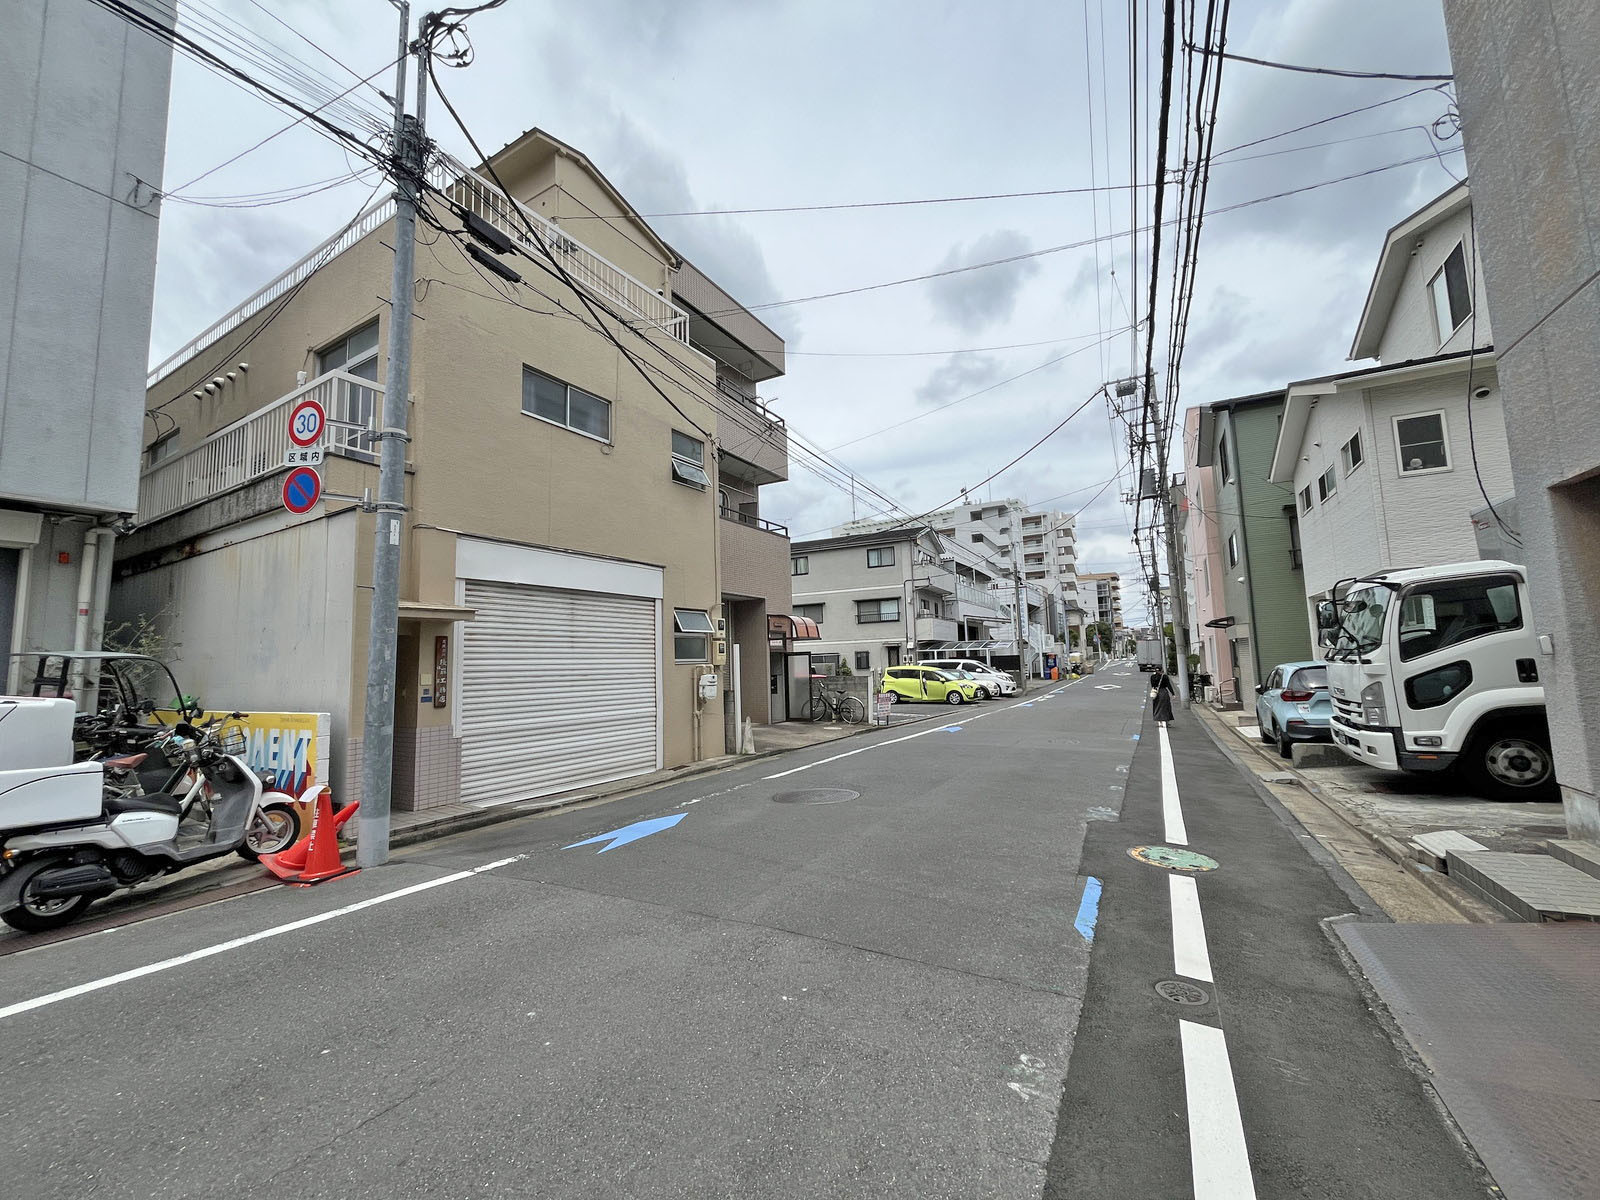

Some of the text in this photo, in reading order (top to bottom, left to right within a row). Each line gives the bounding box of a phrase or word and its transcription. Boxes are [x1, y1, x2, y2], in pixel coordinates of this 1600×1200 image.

[296, 413, 317, 434] 30
[288, 451, 320, 463] 区域内
[225, 725, 312, 773] OMENT
